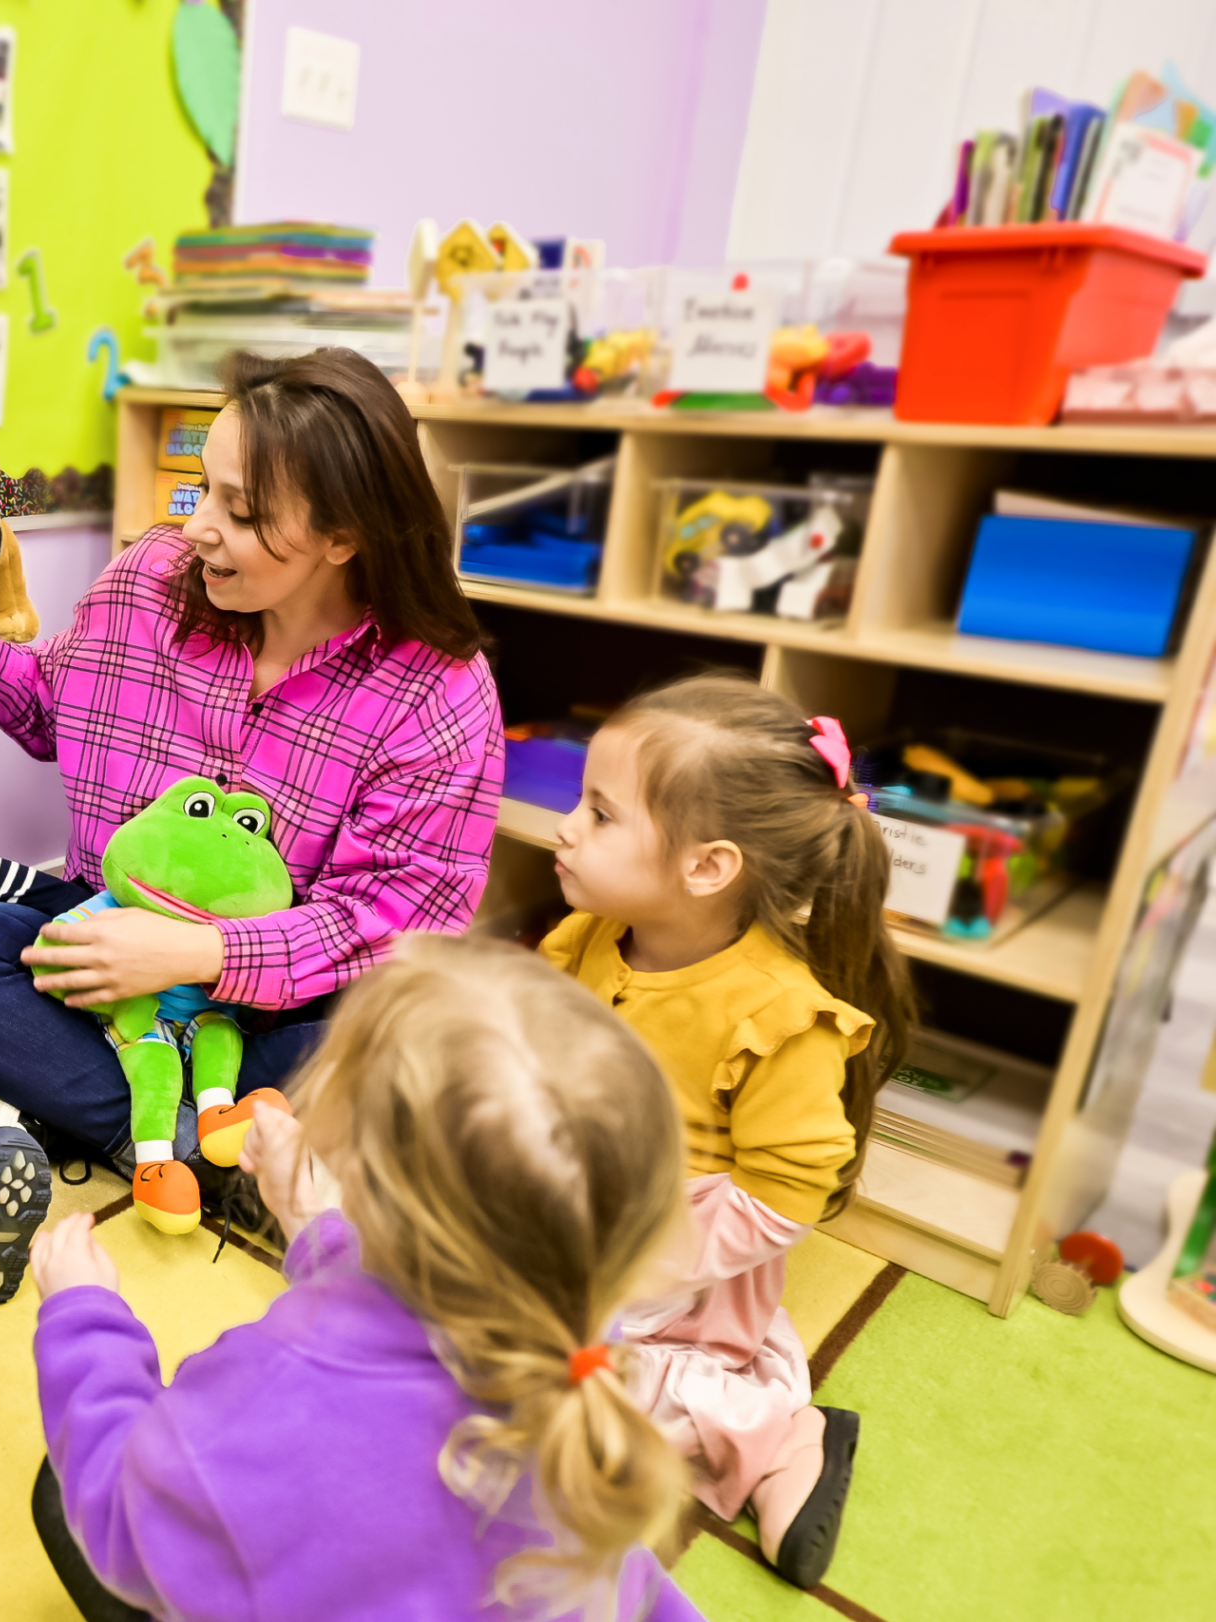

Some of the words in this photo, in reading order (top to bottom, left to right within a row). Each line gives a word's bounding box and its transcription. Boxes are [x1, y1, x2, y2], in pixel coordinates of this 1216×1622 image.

[16, 247, 57, 336] 1
[169, 430, 208, 443] WATE
[166, 442, 203, 457] BLOC
[171, 490, 200, 503] WAT
[168, 502, 195, 516] BLO
[874, 820, 928, 846] ristle
[889, 848, 927, 874] lders
